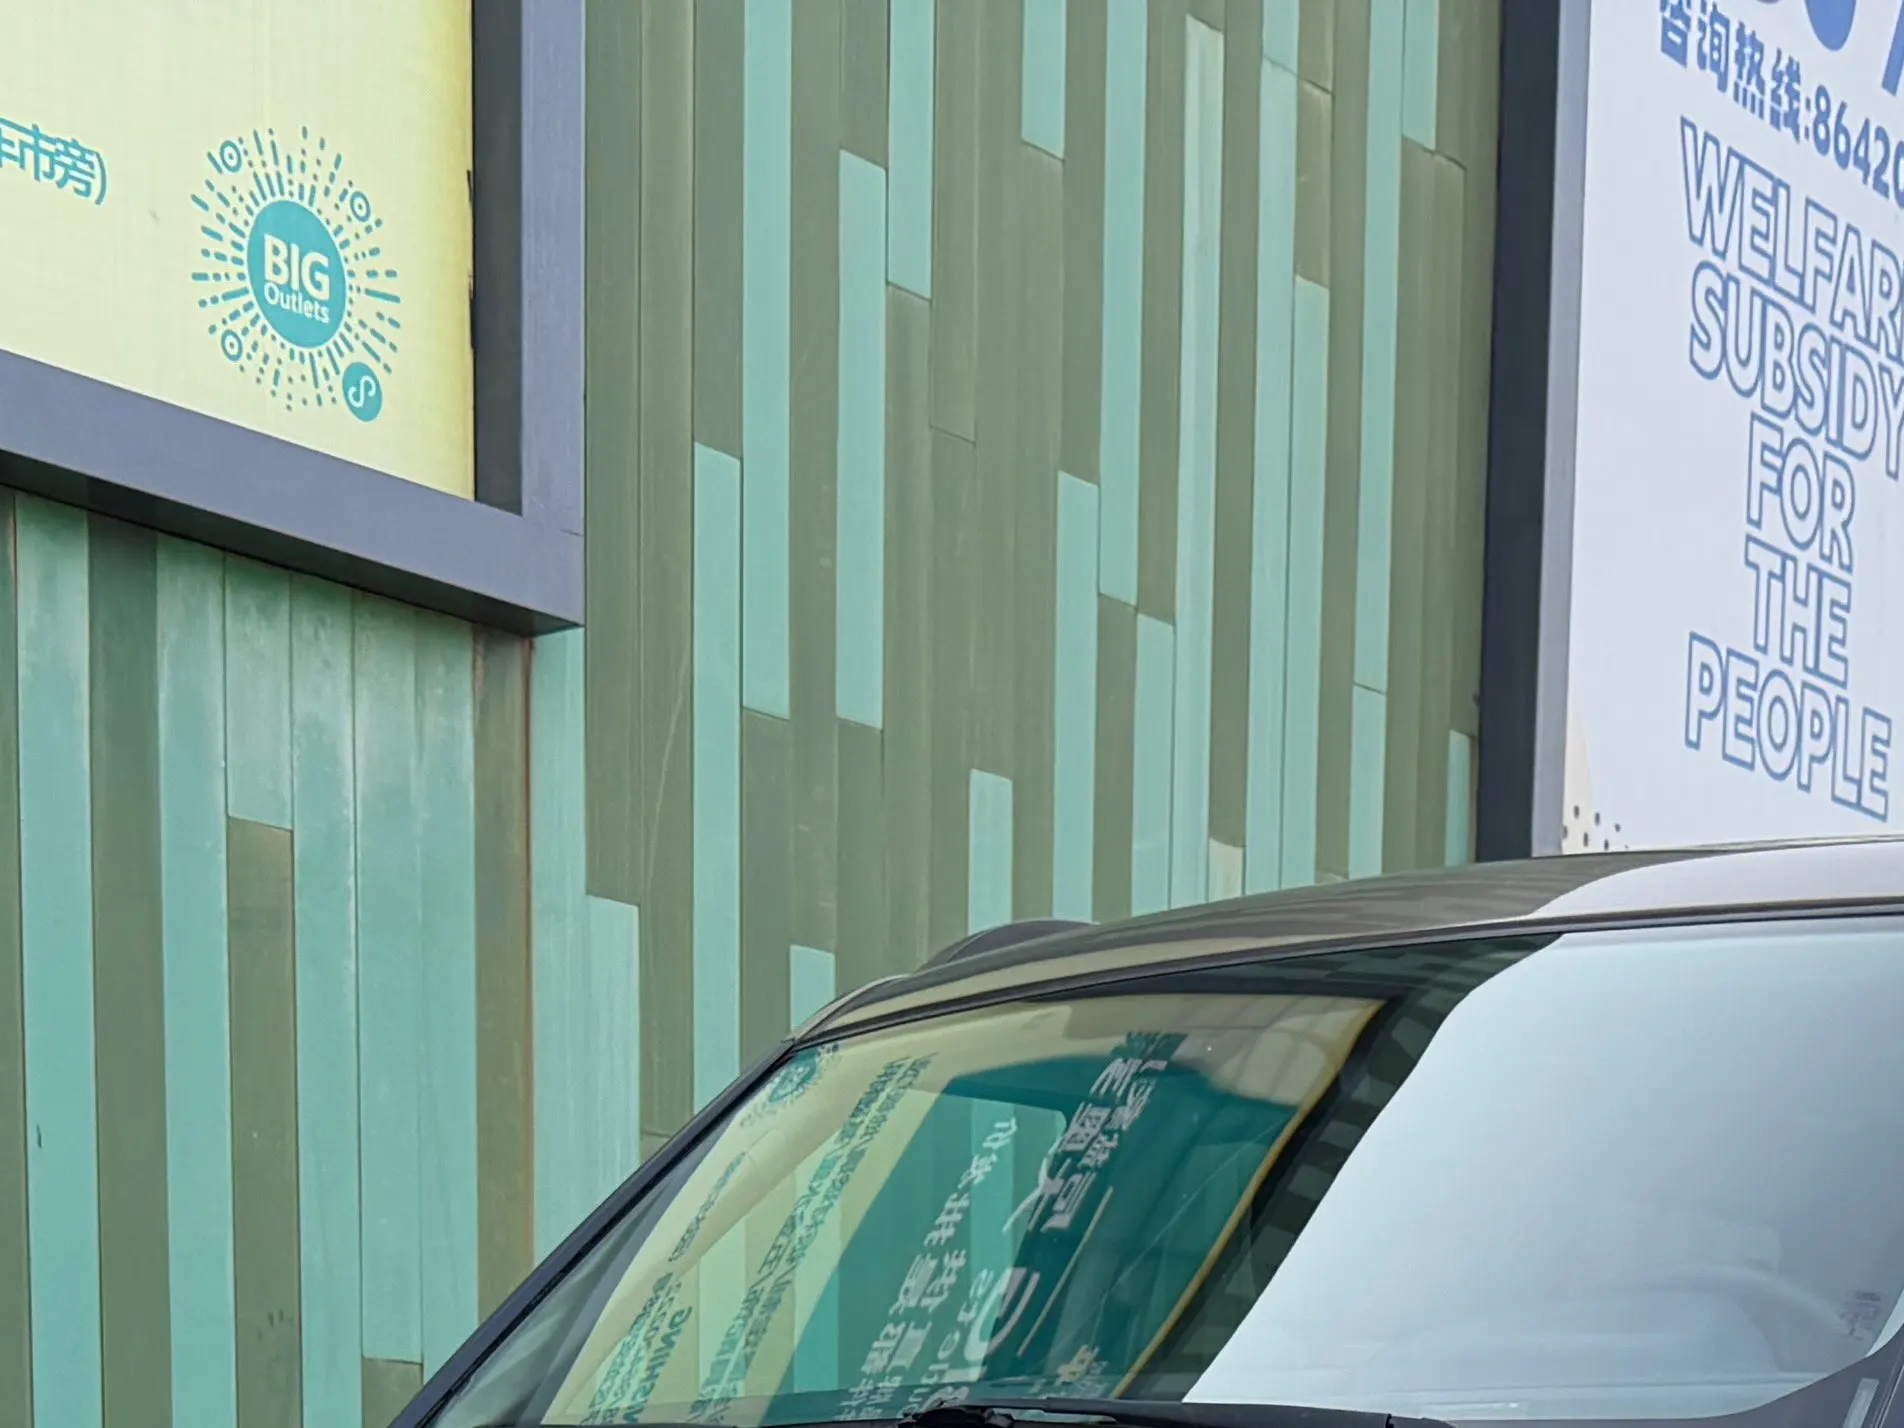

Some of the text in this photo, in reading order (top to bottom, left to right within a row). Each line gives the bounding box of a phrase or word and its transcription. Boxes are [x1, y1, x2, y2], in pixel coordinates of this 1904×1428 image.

[263, 282, 330, 324] Outlets
[264, 233, 330, 300] BIG
[1745, 411, 1856, 576] FOR
[1744, 533, 1852, 690] THE
[1684, 630, 1893, 822] PEOPLE
